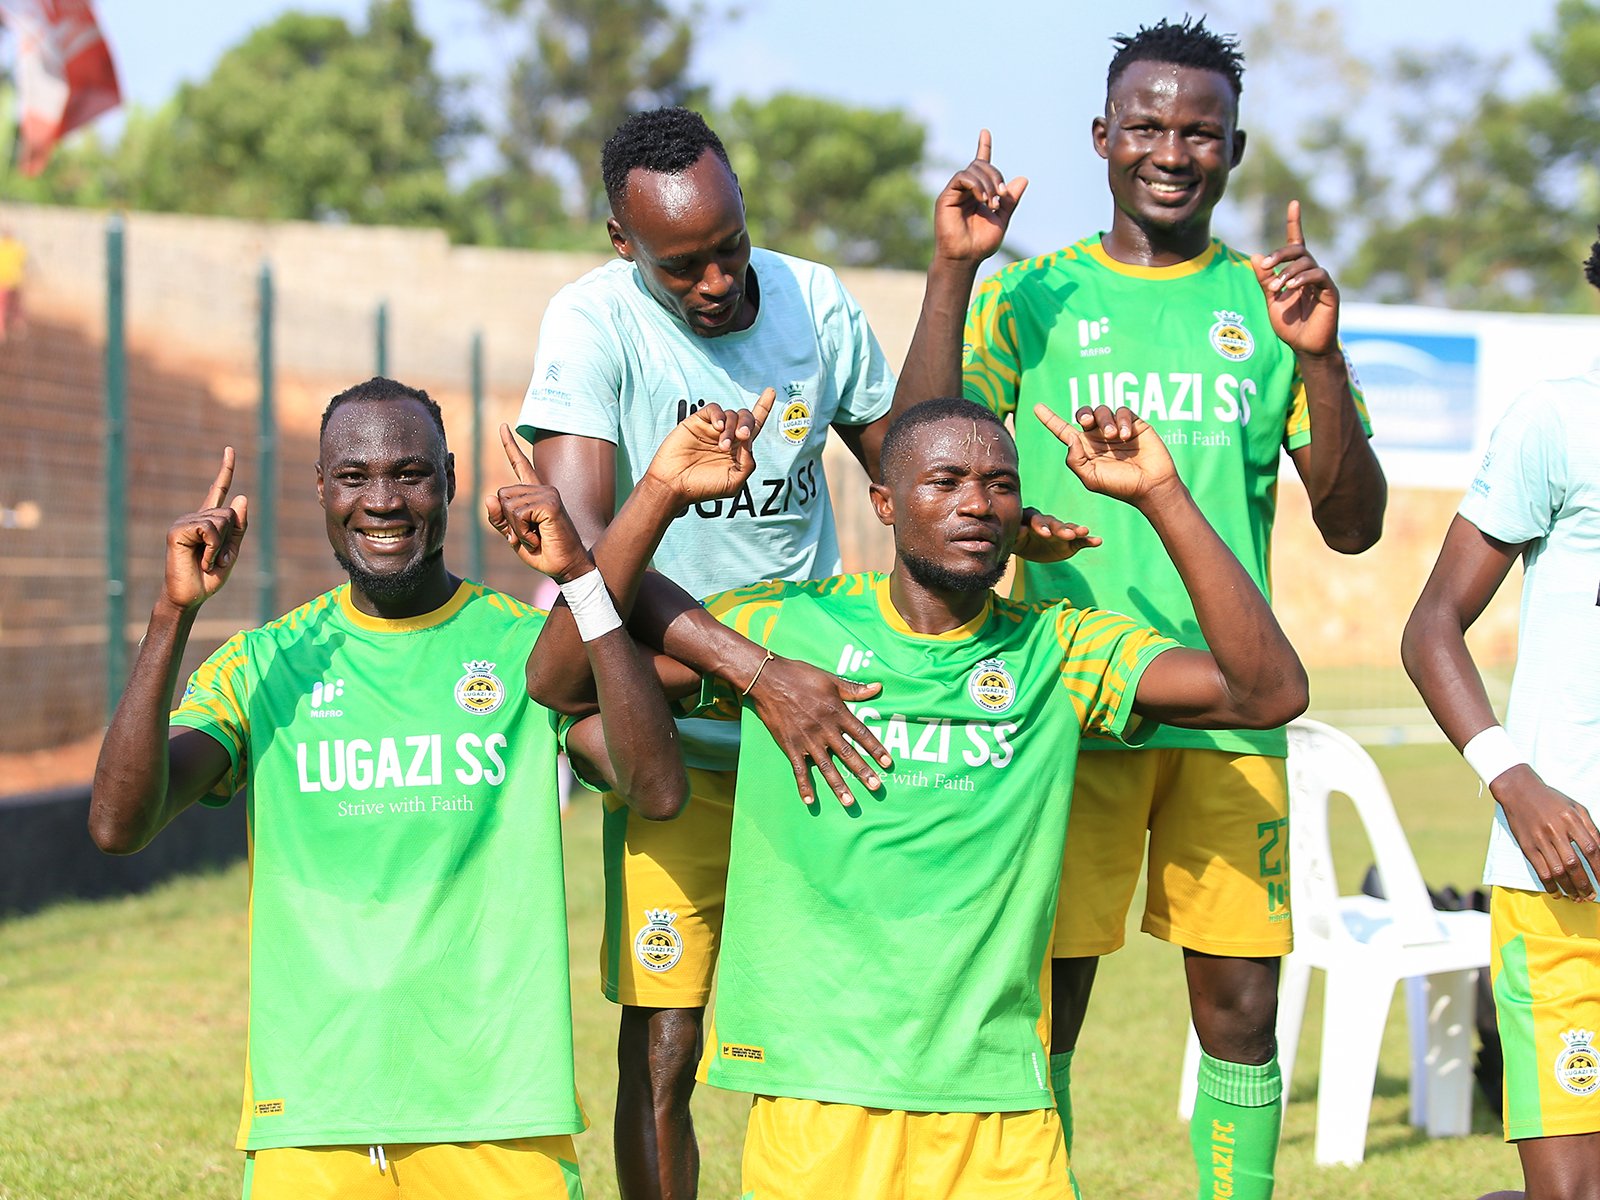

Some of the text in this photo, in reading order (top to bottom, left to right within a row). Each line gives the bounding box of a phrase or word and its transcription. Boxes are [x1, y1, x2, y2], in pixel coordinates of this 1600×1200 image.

[1213, 373, 1257, 427] SS
[1192, 430, 1231, 446] Faith
[797, 459, 817, 506] SS
[962, 718, 1018, 769] SS
[296, 732, 508, 793] LUGAZI SS
[892, 770, 929, 789] with
[934, 773, 976, 792] Faith
[337, 794, 474, 817] Strive with Faith
[1211, 1119, 1235, 1145] FC
